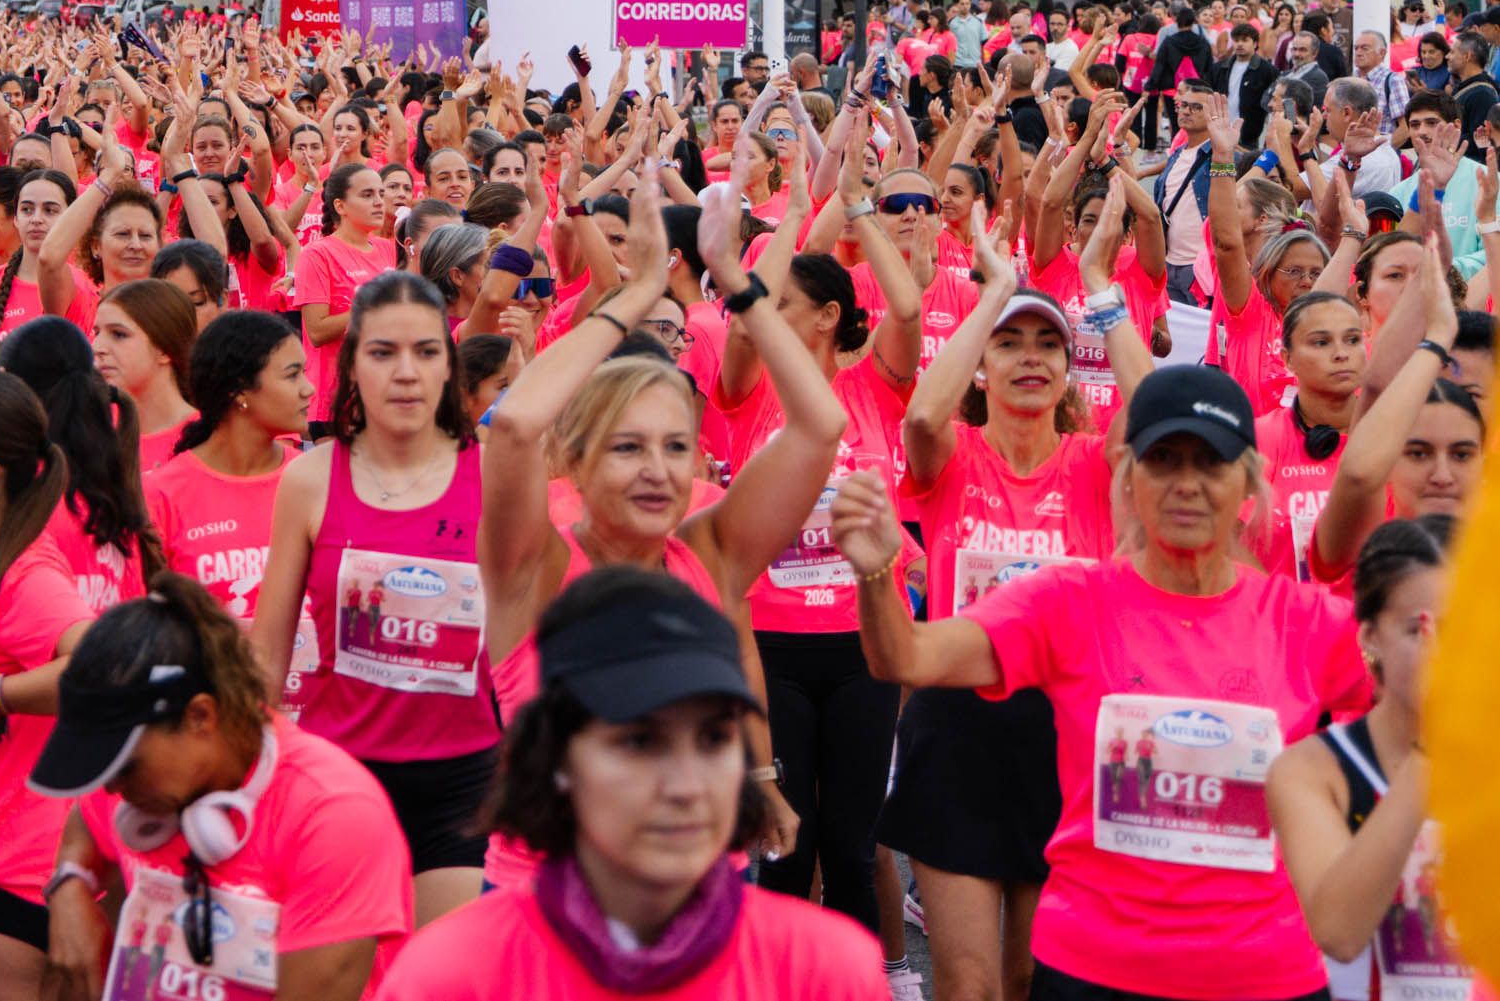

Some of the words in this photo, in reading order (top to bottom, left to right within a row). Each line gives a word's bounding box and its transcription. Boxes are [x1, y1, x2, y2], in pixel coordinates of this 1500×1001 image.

[617, 2, 745, 21] CORREDORAS
[5, 307, 25, 318] SHO
[1075, 346, 1105, 360] 016
[1281, 465, 1326, 478] OYSHO
[187, 519, 237, 541] OYSHO
[803, 527, 830, 546] 01
[961, 516, 1067, 558] CARRERA
[389, 575, 442, 593] ASTURIANA
[783, 569, 820, 582] OYSHO
[381, 616, 438, 645] 016
[350, 661, 391, 678] OYSHO
[1161, 721, 1229, 742] ASTURIANA
[1155, 771, 1225, 806] 016
[1113, 830, 1170, 849] OYSHO
[159, 963, 227, 1001] 016
